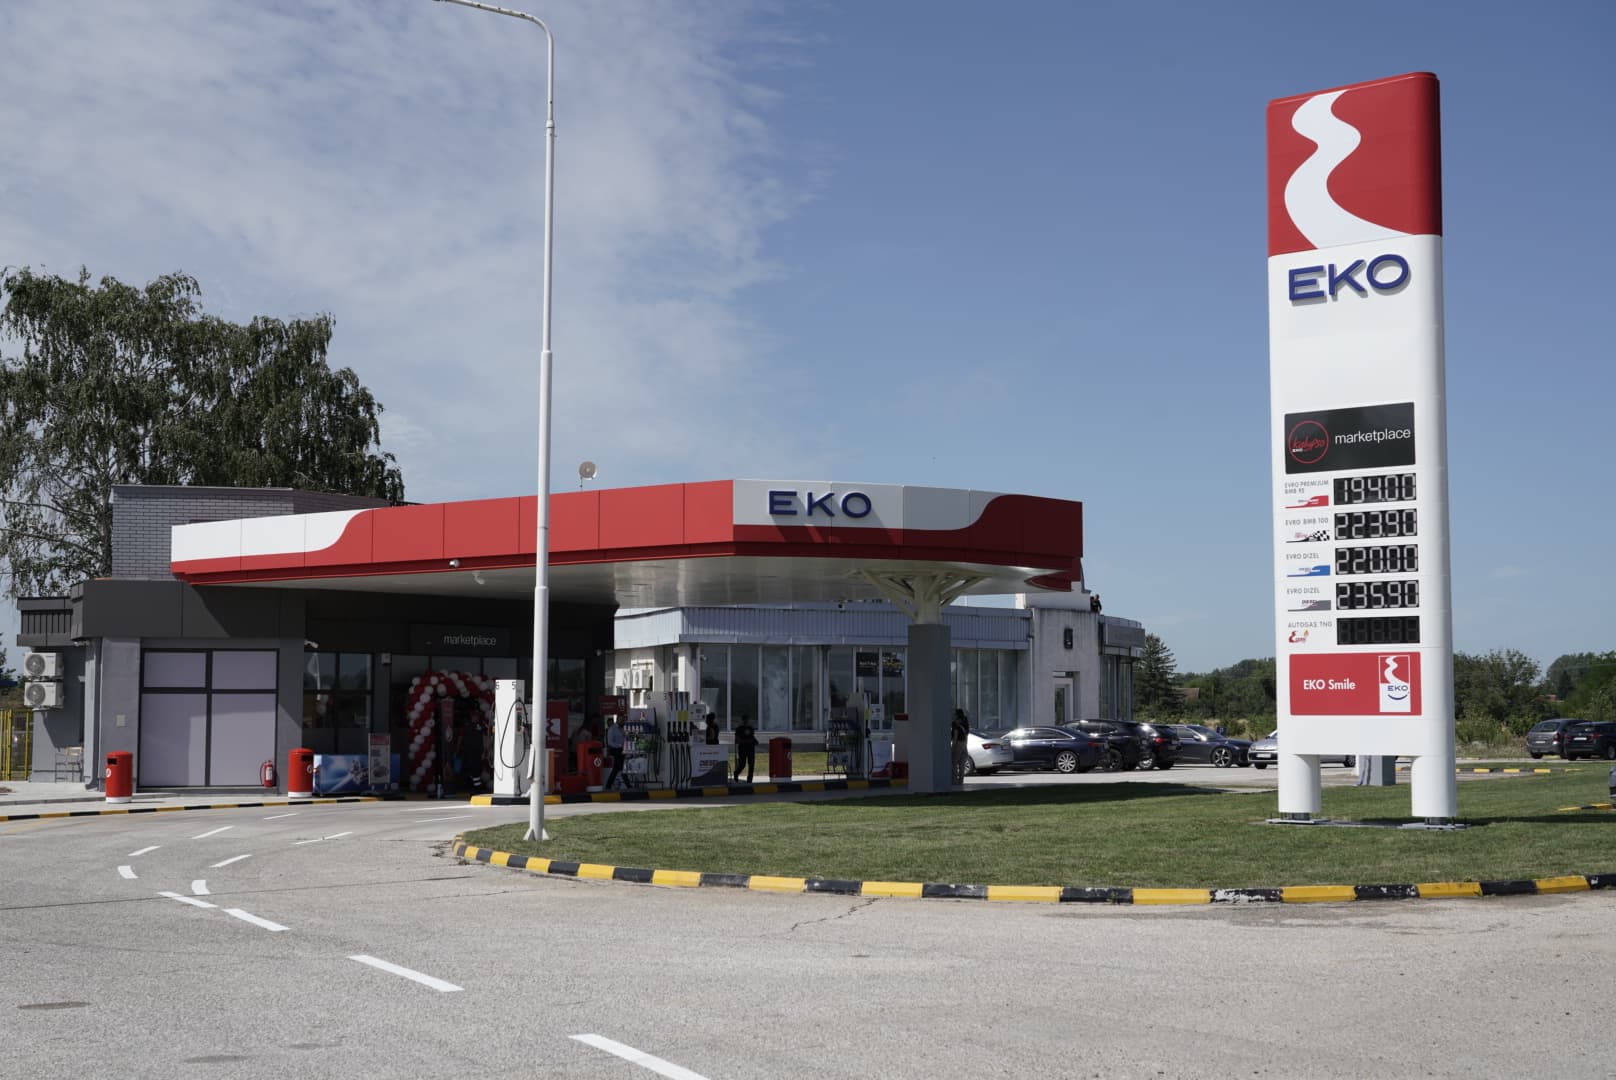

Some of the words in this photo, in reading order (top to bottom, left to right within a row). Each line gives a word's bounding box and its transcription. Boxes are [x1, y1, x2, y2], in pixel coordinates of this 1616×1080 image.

[1288, 253, 1409, 301] EKO
[1335, 428, 1411, 445] marketplace
[1344, 474, 1416, 504] 194.00
[768, 491, 872, 518] EKO
[1335, 509, 1417, 539] 223.90
[1336, 545, 1418, 574] 220.00
[1337, 580, 1419, 610] 235.90
[443, 634, 497, 648] marketplace
[1303, 679, 1326, 690] EKO
[1328, 677, 1356, 690] Smile
